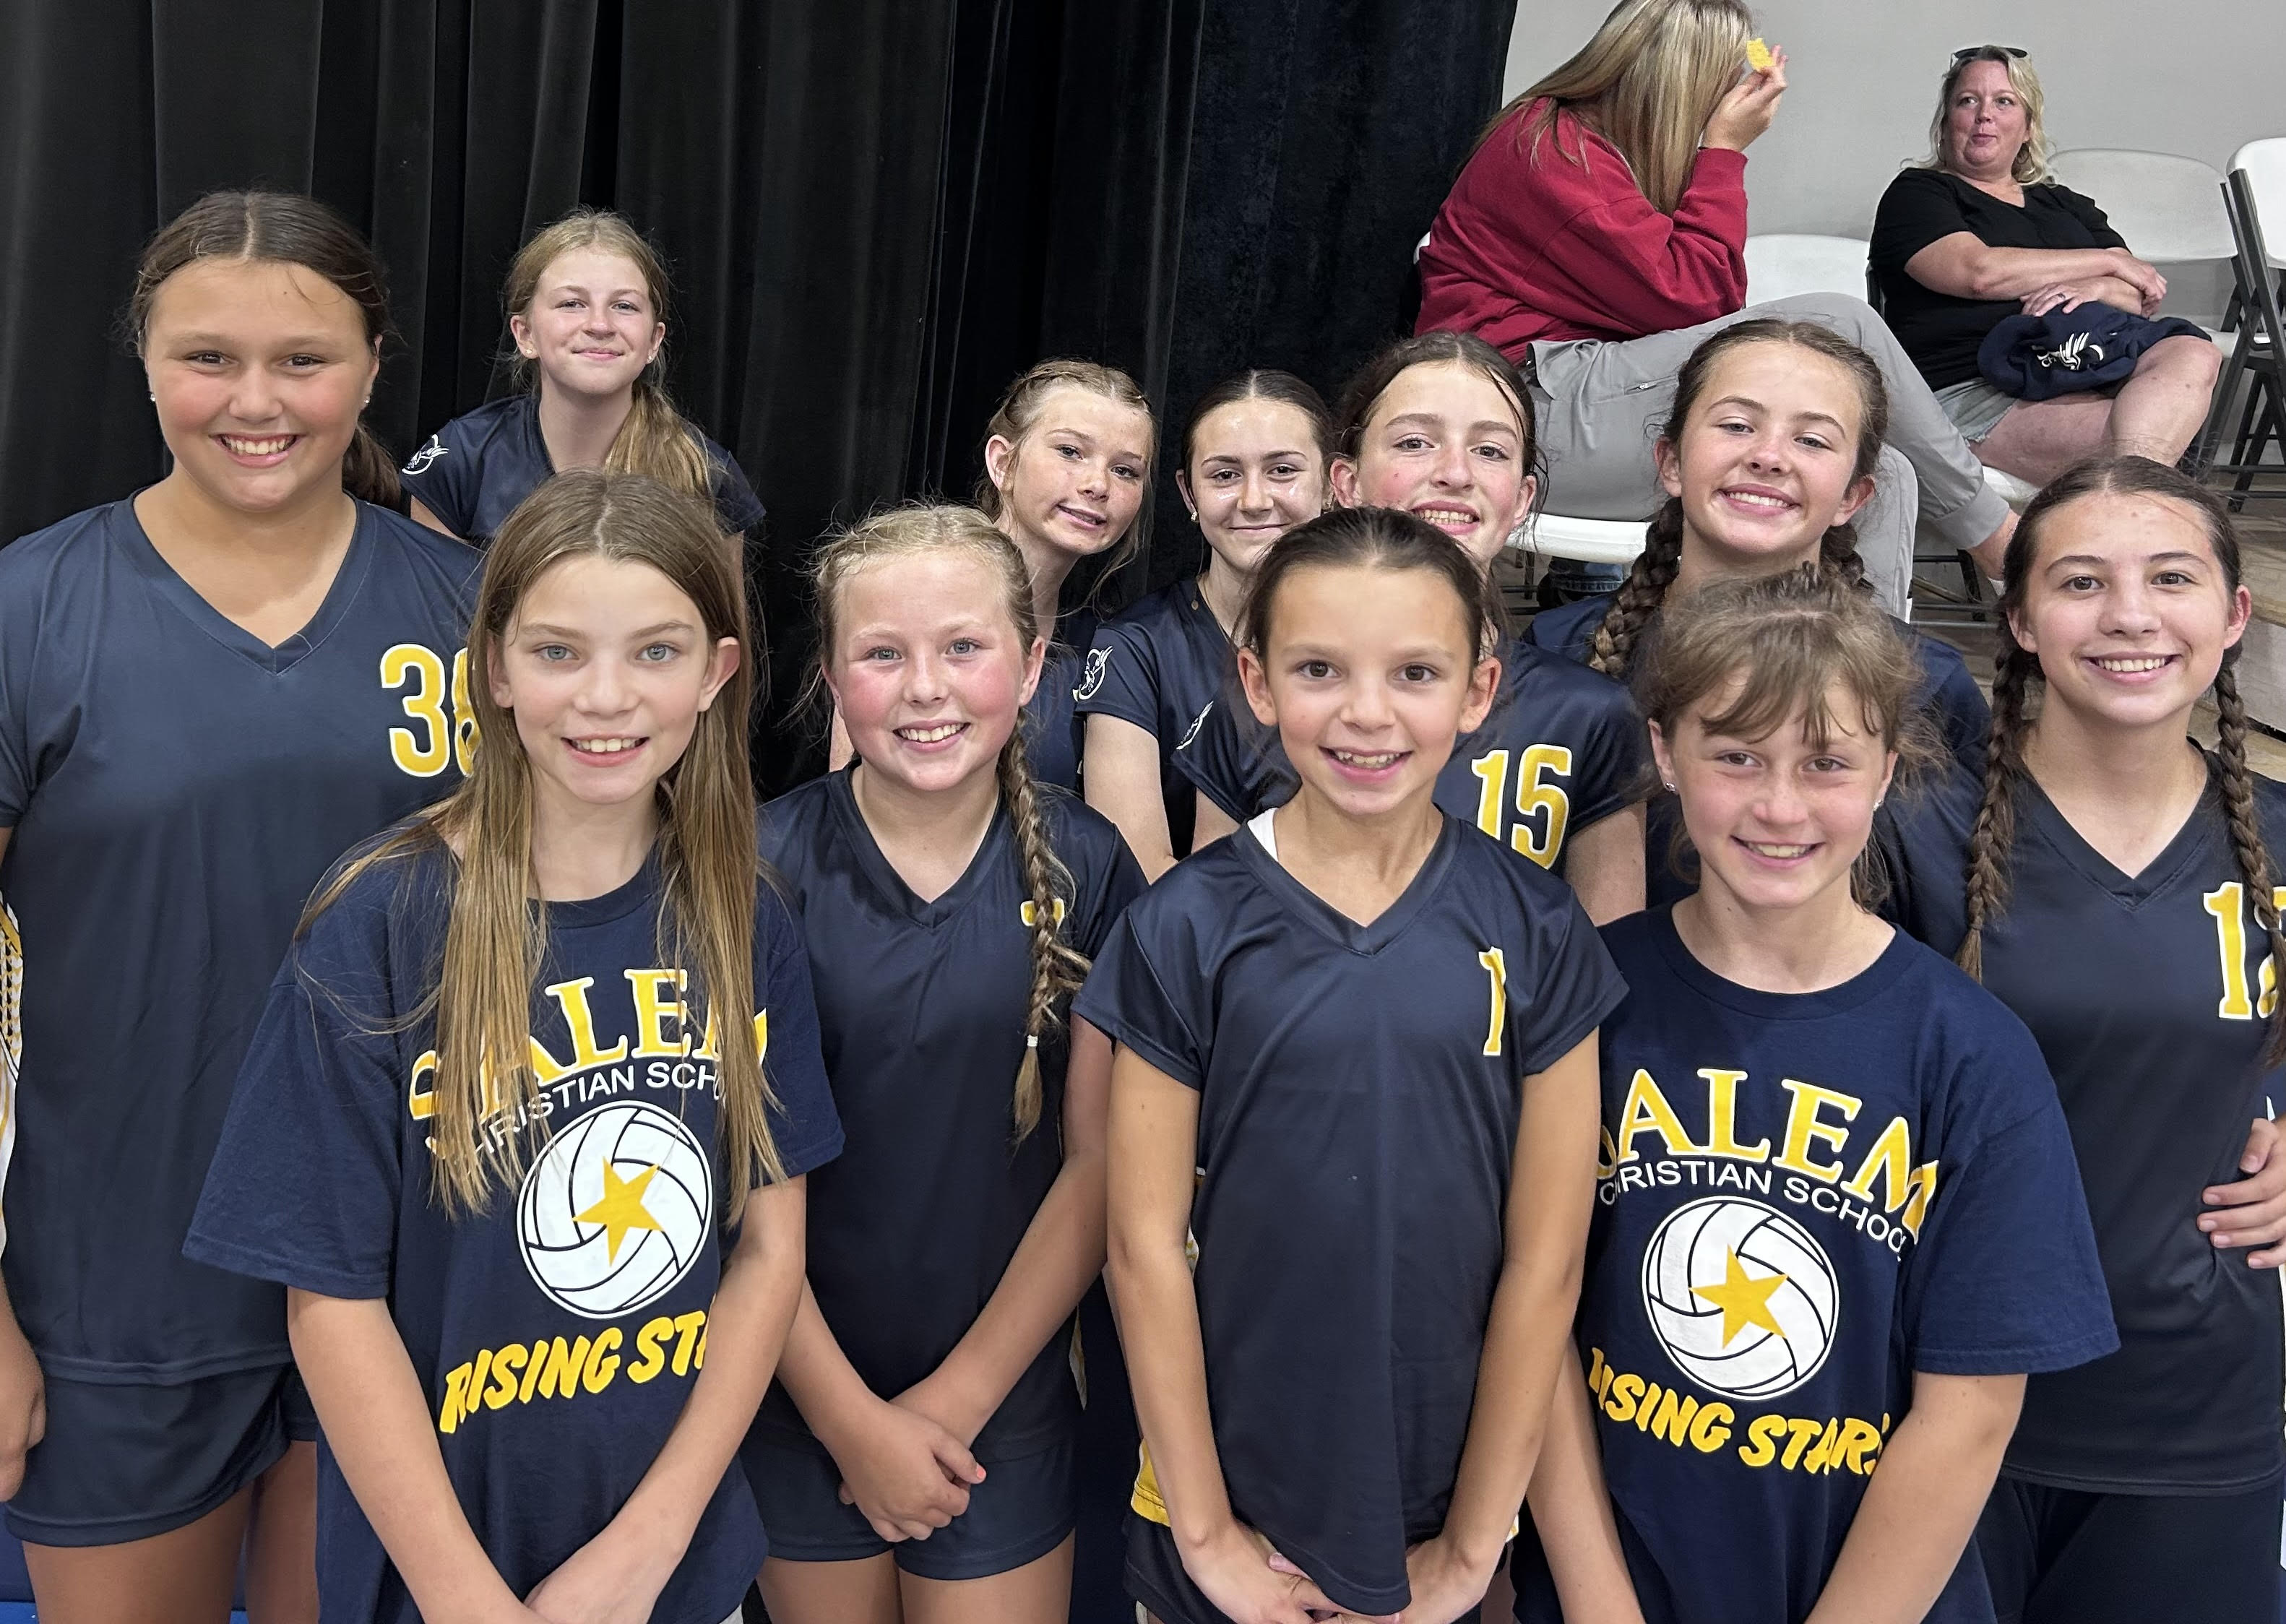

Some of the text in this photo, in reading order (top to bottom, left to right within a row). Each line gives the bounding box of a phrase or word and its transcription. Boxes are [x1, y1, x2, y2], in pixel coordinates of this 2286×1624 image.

[1471, 743, 1572, 870] 15
[1478, 946, 1507, 1056] 1
[424, 1061, 726, 1159] RISTIAN SCH
[1782, 1176, 1907, 1262] SCHOO
[439, 1326, 624, 1434] RISING
